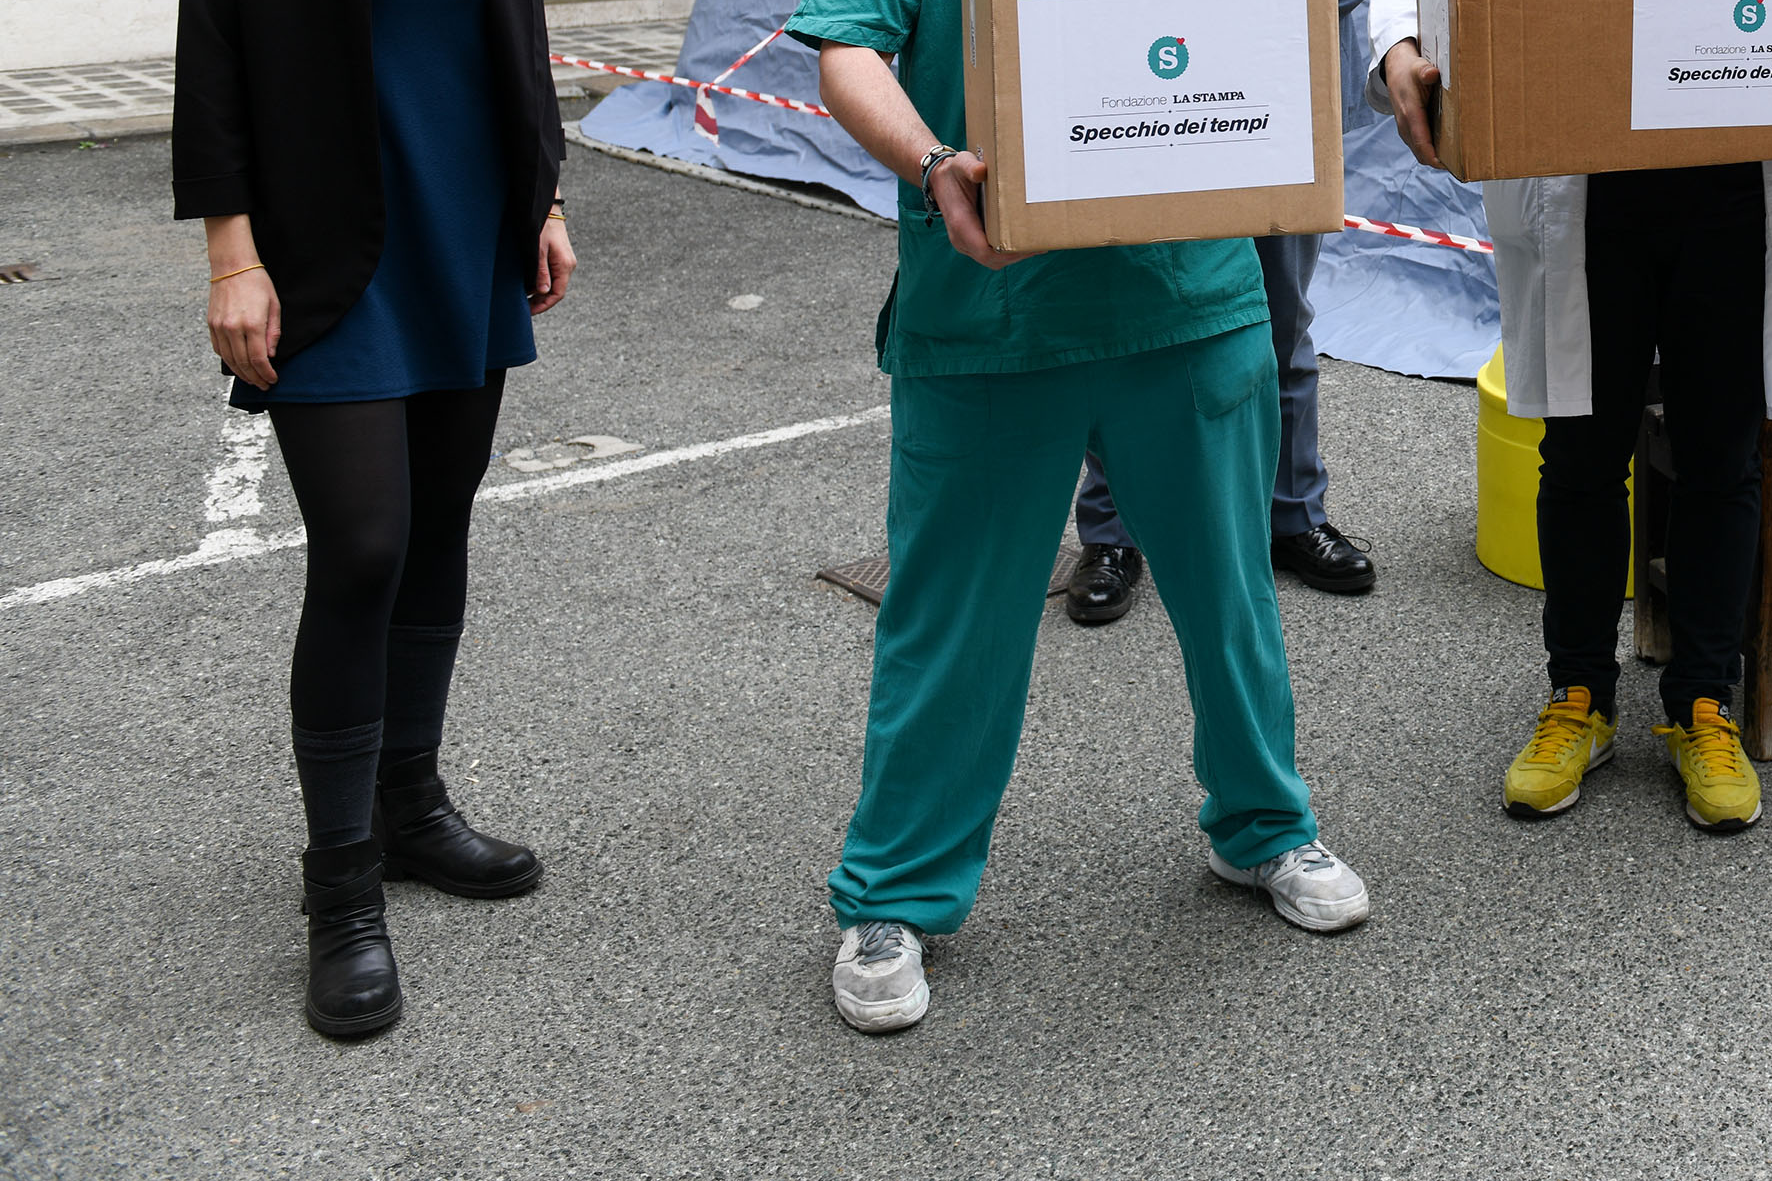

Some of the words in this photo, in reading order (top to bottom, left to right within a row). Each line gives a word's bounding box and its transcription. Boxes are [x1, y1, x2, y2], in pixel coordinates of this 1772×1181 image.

[1741, 5, 1758, 25] S
[1158, 46, 1179, 70] S
[1694, 44, 1747, 55] Fondazione
[1751, 45, 1765, 53] LA
[1668, 66, 1747, 83] Specchio
[1101, 95, 1167, 109] Fondazione
[1172, 94, 1191, 104] LA
[1192, 91, 1246, 103] STAMPA
[1069, 120, 1170, 145] Specchio
[1174, 117, 1208, 135] dei
[1210, 114, 1270, 134] tempi
